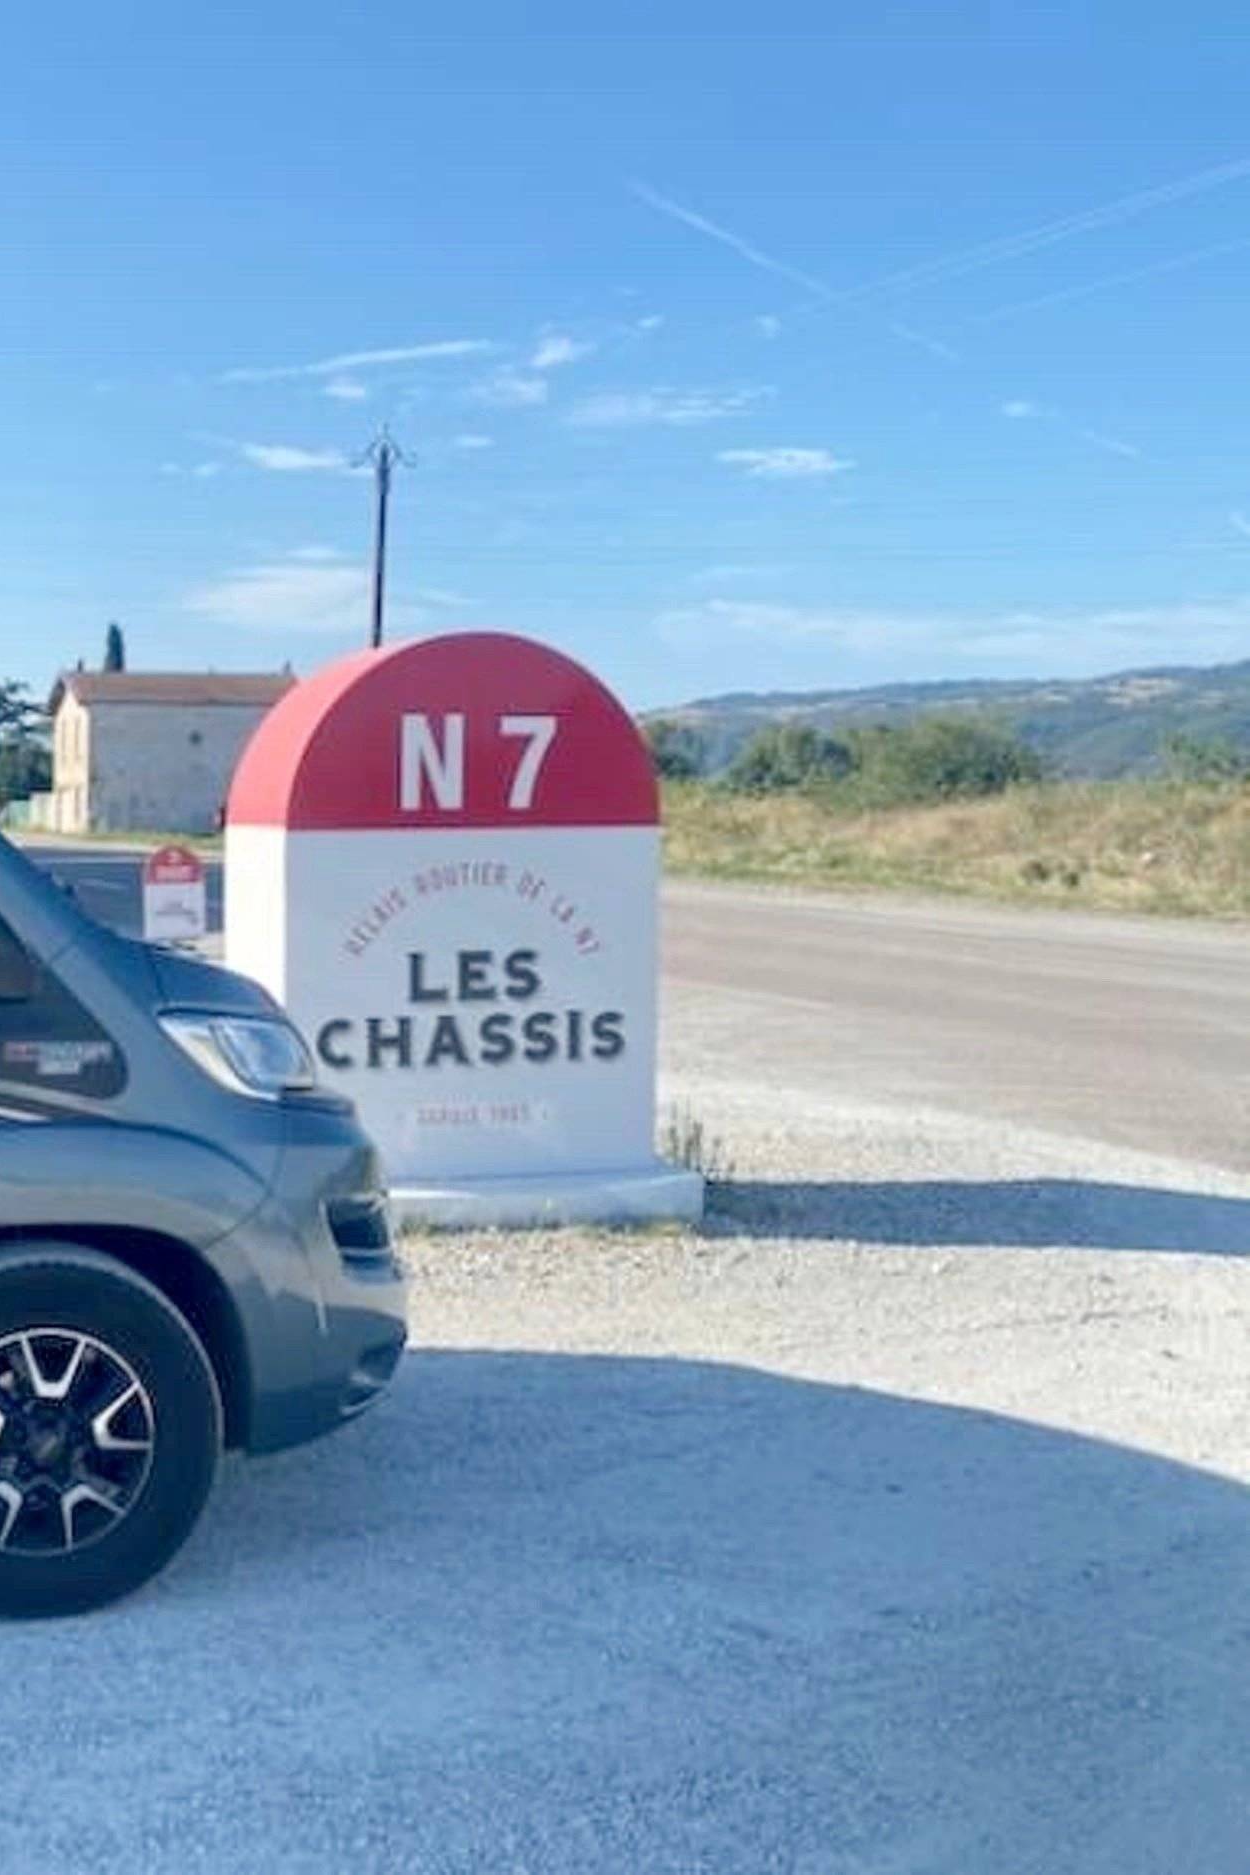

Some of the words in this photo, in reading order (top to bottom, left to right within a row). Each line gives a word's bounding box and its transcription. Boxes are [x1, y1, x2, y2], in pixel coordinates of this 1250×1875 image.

[400, 712, 464, 811] N
[500, 714, 558, 809] 7
[407, 949, 543, 1003] LES
[315, 1009, 627, 1070] CHASSIS
